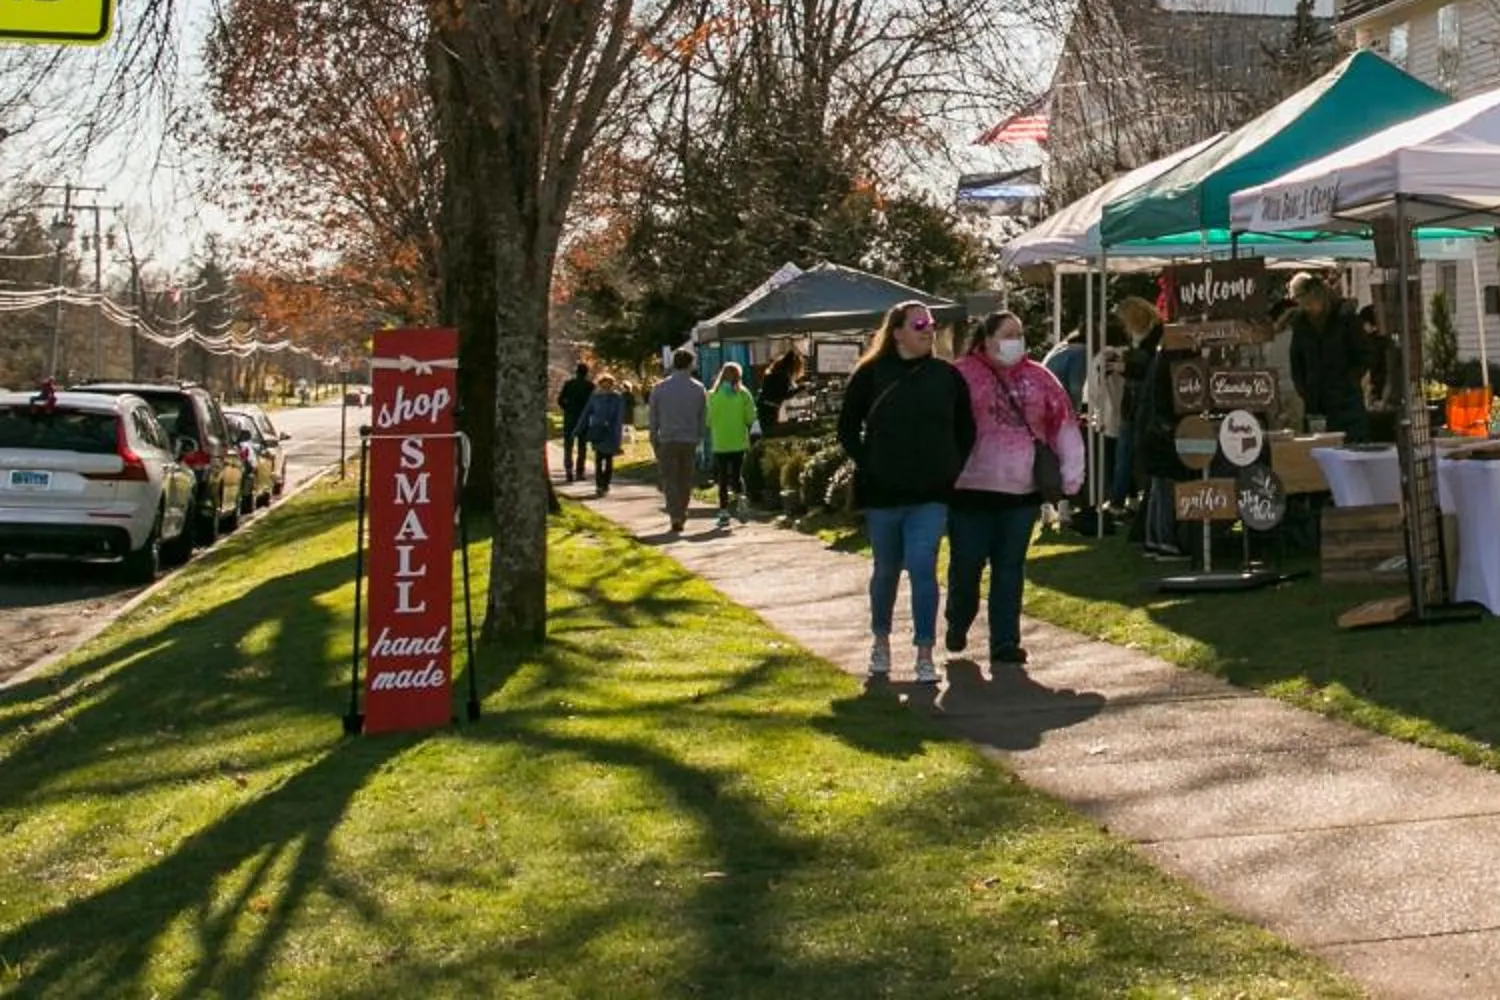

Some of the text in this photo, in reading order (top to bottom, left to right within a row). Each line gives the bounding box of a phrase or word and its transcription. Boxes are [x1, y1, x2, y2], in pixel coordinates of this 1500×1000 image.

[1180, 267, 1255, 307] welcome
[377, 385, 450, 429] shop
[1179, 486, 1228, 515] gather
[394, 437, 430, 615] SMALL
[371, 625, 448, 659] hand
[371, 659, 447, 691] made
